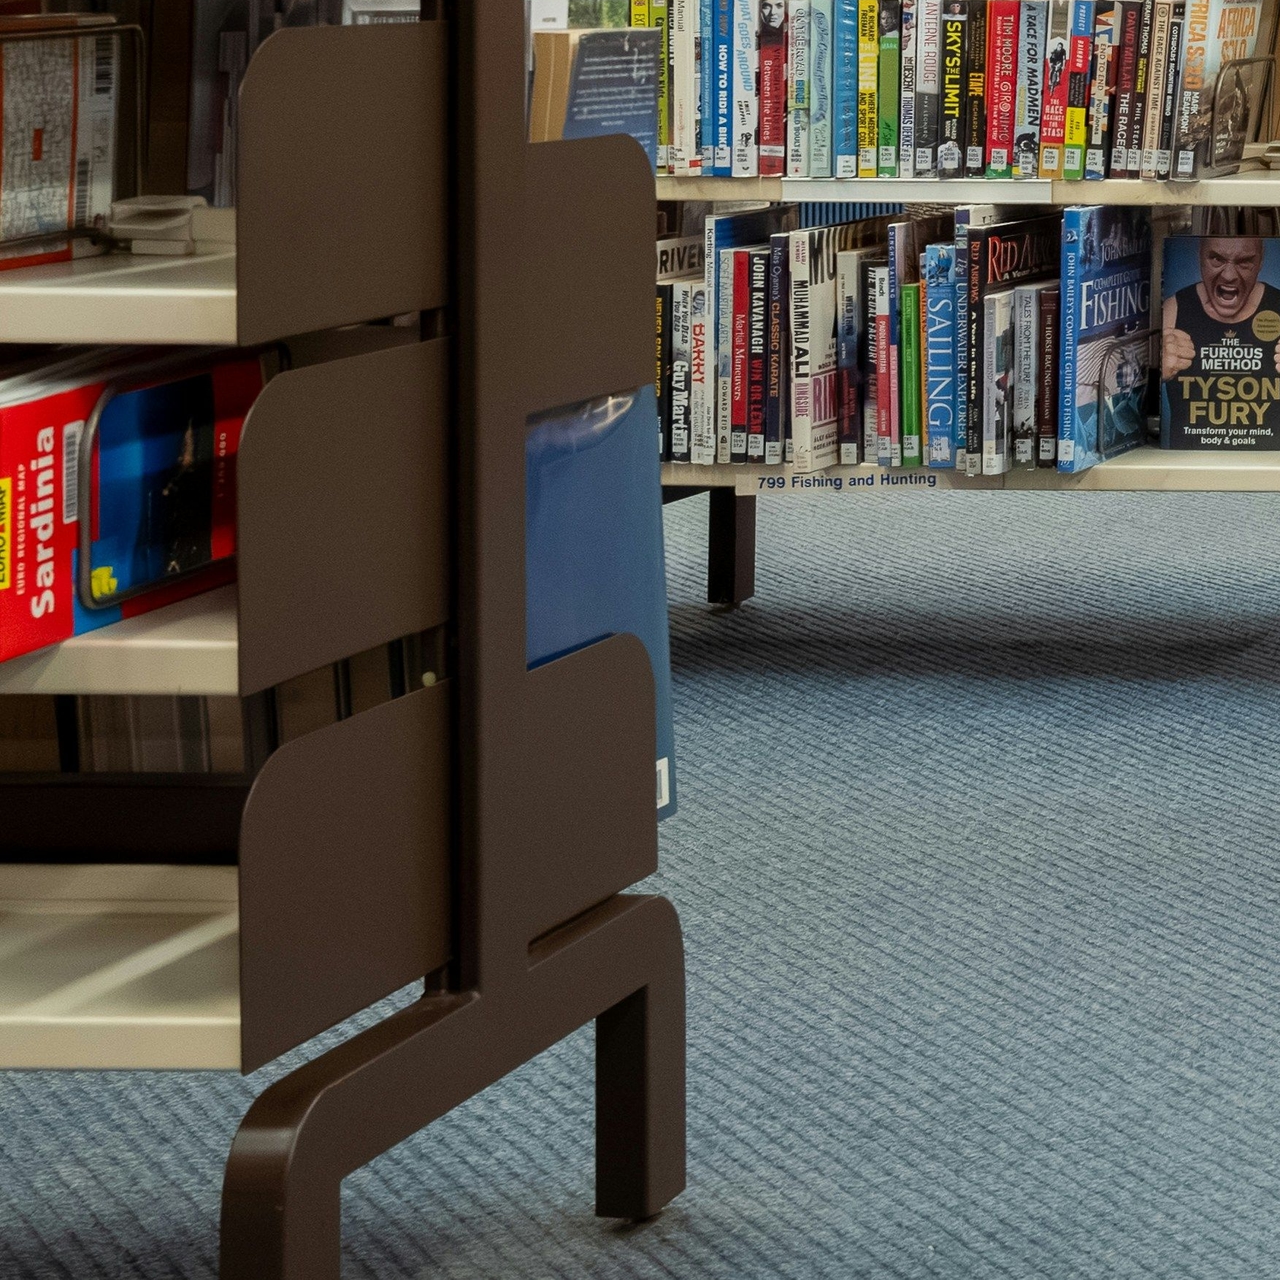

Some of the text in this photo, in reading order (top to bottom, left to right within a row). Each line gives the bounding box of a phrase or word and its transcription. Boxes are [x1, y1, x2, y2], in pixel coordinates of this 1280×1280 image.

[945, 21, 961, 67] SKY'S
[945, 76, 959, 118] LIMIT
[794, 280, 810, 379] MUHAMMAD ALI
[1201, 347, 1262, 359] FURIOUS
[1222, 338, 1240, 346] THE
[928, 298, 952, 428] SAILING
[1201, 359, 1262, 370] METHOD
[1178, 377, 1280, 399] TYSON
[1190, 402, 1270, 424] FURY
[1184, 427, 1226, 435] Transform
[1249, 428, 1273, 436] mind,
[1201, 436, 1222, 446] body
[1232, 437, 1255, 446] goals
[758, 474, 936, 490] 799 Fishing and Hunting
[31, 426, 54, 618] Sardinia
